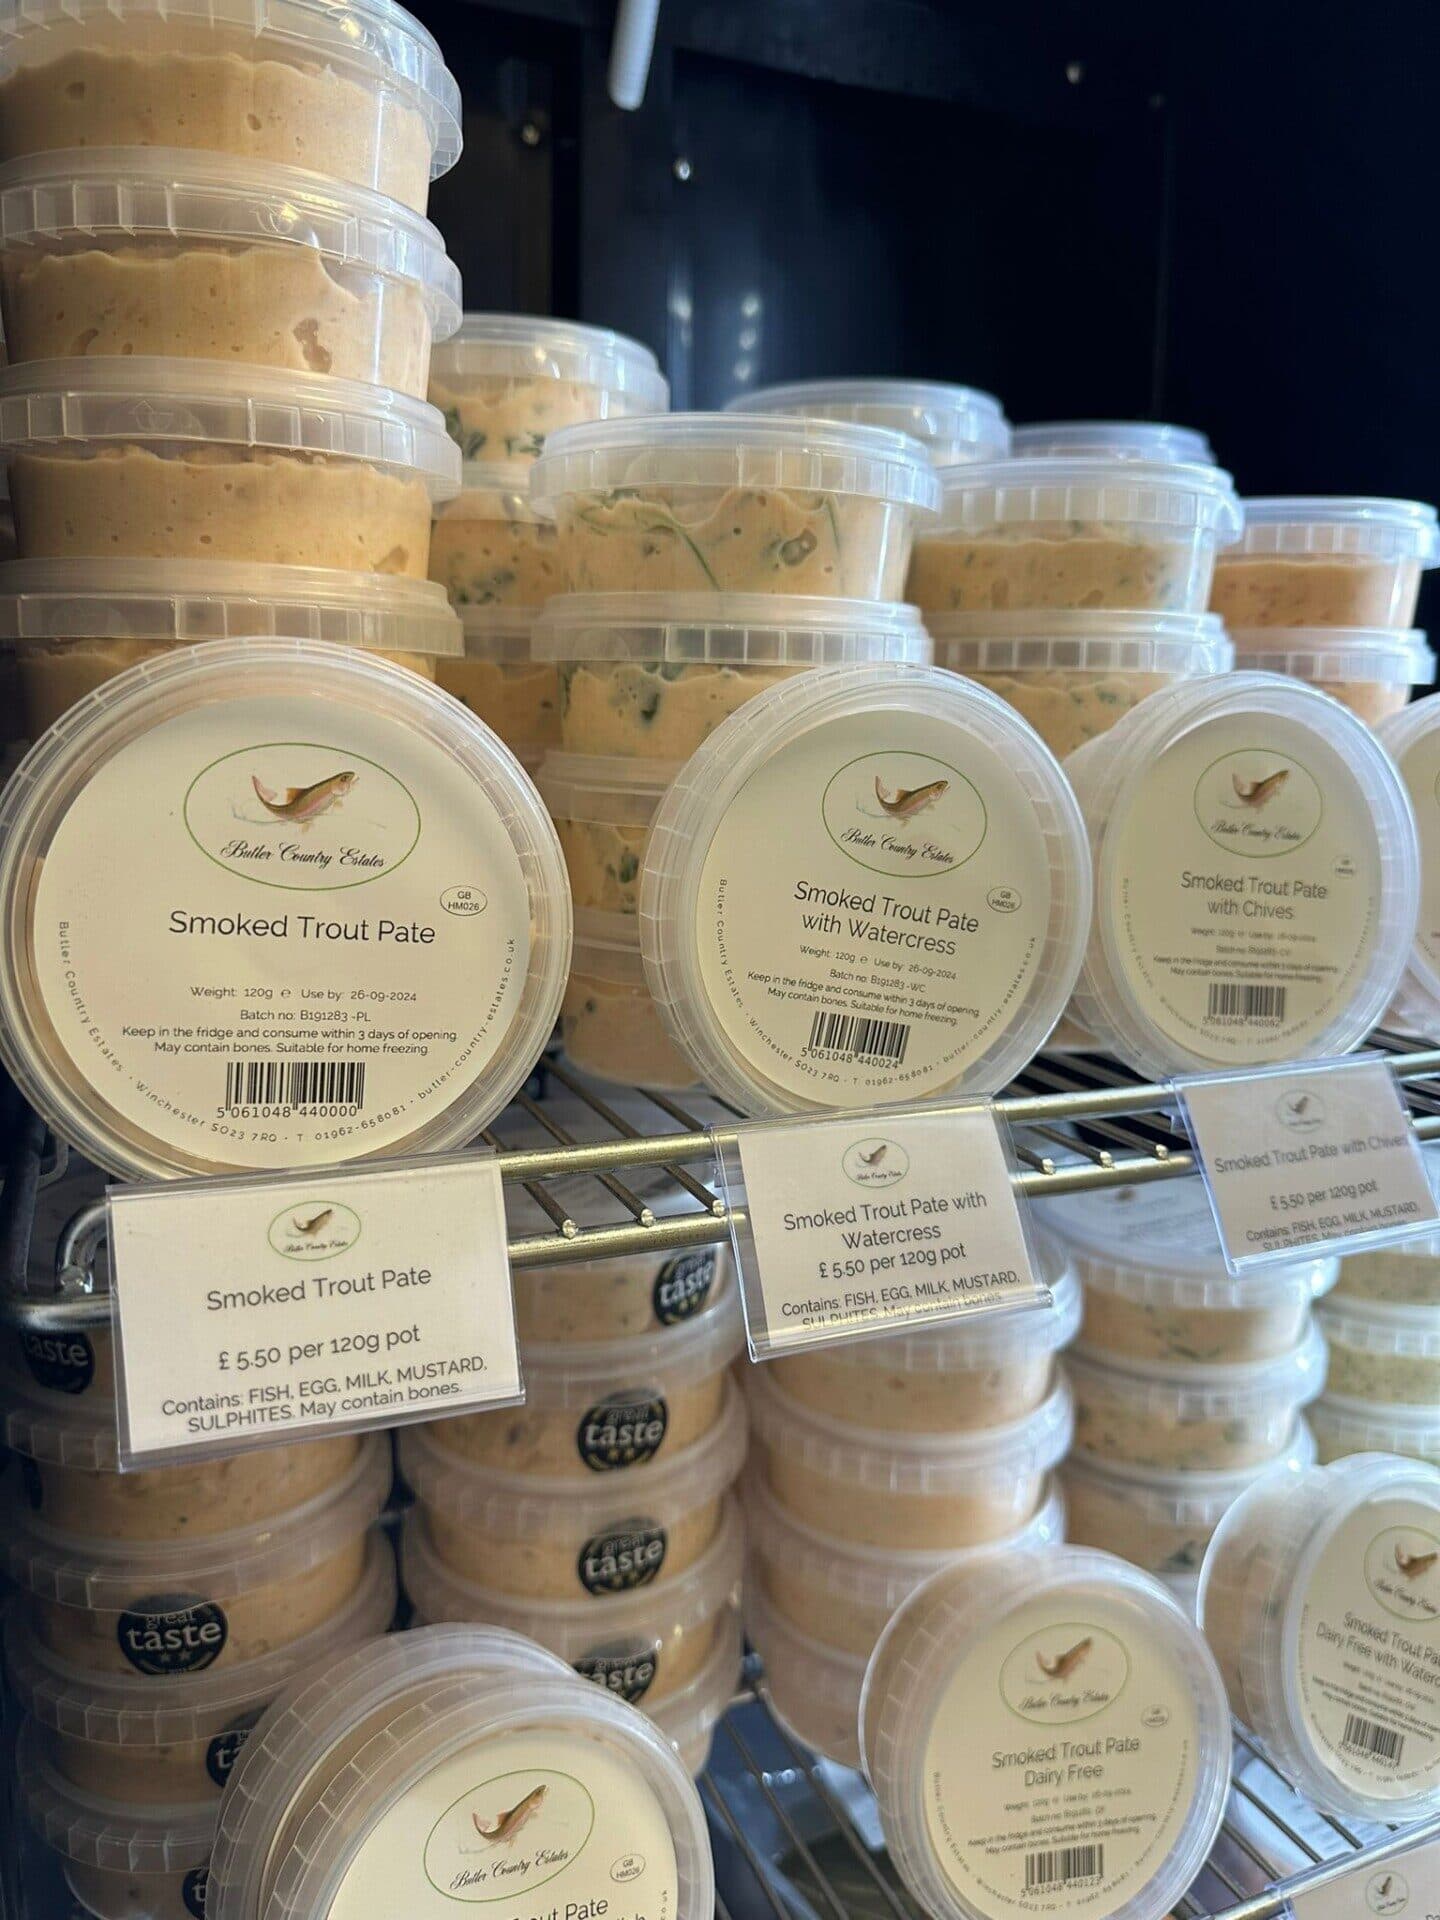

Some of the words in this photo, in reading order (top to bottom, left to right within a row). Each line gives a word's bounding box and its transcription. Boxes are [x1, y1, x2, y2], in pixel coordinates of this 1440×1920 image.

[220, 840, 272, 860] Butler
[279, 842, 332, 869] Country
[339, 846, 385, 868] Estates
[840, 828, 876, 847] Butler
[881, 834, 918, 859] Country
[921, 842, 955, 864] Estates
[457, 890, 471, 900] GB
[1180, 871, 1244, 893] Smoked
[1248, 876, 1289, 897] Trout
[1293, 880, 1329, 900] Pate
[448, 900, 480, 911] HM026
[794, 880, 876, 913] Smoked
[882, 896, 932, 924] Trout
[936, 907, 980, 933] Pate
[1207, 898, 1238, 916] with
[1242, 900, 1295, 920] Chives
[169, 911, 288, 938] Smoked
[297, 916, 370, 941] Trout
[378, 920, 436, 944] Pate
[802, 912, 841, 935] with
[848, 918, 956, 956] Watercress
[829, 968, 854, 982] Batch
[835, 951, 856, 964] 120g
[874, 957, 890, 969] Use
[908, 964, 957, 980] 26-09-2024
[244, 988, 273, 1000] 120g
[301, 988, 325, 1000] Use
[350, 989, 417, 1002] 26-09-2024
[747, 970, 771, 984] Keep
[772, 974, 781, 983] in
[782, 976, 797, 987] the
[798, 978, 824, 993] fridge
[825, 983, 841, 994] and
[843, 987, 882, 1001] consume
[883, 992, 908, 1005] within
[909, 998, 915, 1008] 3
[916, 998, 935, 1011] days
[936, 1000, 947, 1011] of
[767, 987, 786, 1001] May
[788, 990, 819, 1003] contain
[850, 999, 884, 1014] Suitable
[886, 1005, 898, 1015] for
[899, 1008, 922, 1020] home
[59, 921, 71, 964] Butler
[65, 970, 91, 1025] Country
[88, 1027, 123, 1072] Estates
[136, 1080, 205, 1127] Winchester
[211, 1122, 245, 1140] SO23
[240, 1009, 275, 1021] Batch
[278, 1011, 296, 1022] no:
[300, 1010, 348, 1023] B191283
[122, 1026, 155, 1039] Keep
[158, 1027, 170, 1037] in
[172, 1027, 194, 1037] the
[196, 1027, 233, 1040] fridge
[236, 1027, 260, 1038] and
[262, 1030, 319, 1039] consume
[321, 1028, 355, 1039] within
[358, 1030, 366, 1042] 3
[368, 1029, 395, 1042] days
[397, 1029, 411, 1040] of
[412, 1030, 457, 1043] opening
[154, 1042, 181, 1054] May
[184, 1042, 230, 1053] contain
[276, 1042, 325, 1053] Suitable
[327, 1042, 344, 1053] for
[347, 1043, 380, 1053] home
[383, 1043, 428, 1056] freezing
[1214, 1153, 1270, 1175] Smoked
[1274, 1149, 1306, 1166] Trout
[1309, 1144, 1338, 1161] Pate
[1307, 1189, 1327, 1206] per
[1358, 1179, 1378, 1195] pot
[783, 1206, 857, 1231] Smoked
[860, 1202, 908, 1223] Trout
[911, 1197, 949, 1217] Pate
[952, 1191, 988, 1209] with
[841, 1224, 942, 1250] Watercress
[818, 1262, 829, 1279] £
[832, 1258, 866, 1280] 5.50
[870, 1254, 897, 1273] per
[900, 1247, 938, 1266] 120g
[940, 1241, 967, 1262] pot
[206, 1280, 305, 1311] Smoked
[312, 1272, 375, 1299] Trout
[382, 1266, 432, 1290] Pate
[782, 1297, 842, 1317] Contains:
[218, 1350, 232, 1371] £
[236, 1346, 281, 1370] 5.50
[288, 1343, 324, 1366] per
[331, 1331, 380, 1355] 120g
[386, 1324, 421, 1350] pot
[161, 1392, 244, 1417] Contains:
[300, 1399, 335, 1421] May
[340, 1389, 403, 1412] contain
[408, 1380, 463, 1401] bones.
[585, 1419, 665, 1446] taste
[585, 1539, 664, 1578] taste
[126, 1621, 222, 1651] taste
[1316, 1621, 1345, 1648] Dairy
[1346, 1635, 1372, 1656] Free
[1374, 1648, 1398, 1668] with
[1343, 1611, 1389, 1643] Smoked
[1391, 1631, 1422, 1658] Trout
[991, 1743, 1056, 1769] Smoked
[1060, 1738, 1102, 1759] Trout
[1106, 1735, 1140, 1754] Pate
[1024, 1768, 1063, 1786] Dairy
[1067, 1762, 1104, 1781] Free
[450, 1869, 487, 1890] Butler
[491, 1857, 531, 1878] Country
[535, 1849, 570, 1867] Estates
[623, 1858, 633, 1868] GB
[565, 1898, 608, 1920] Pate
